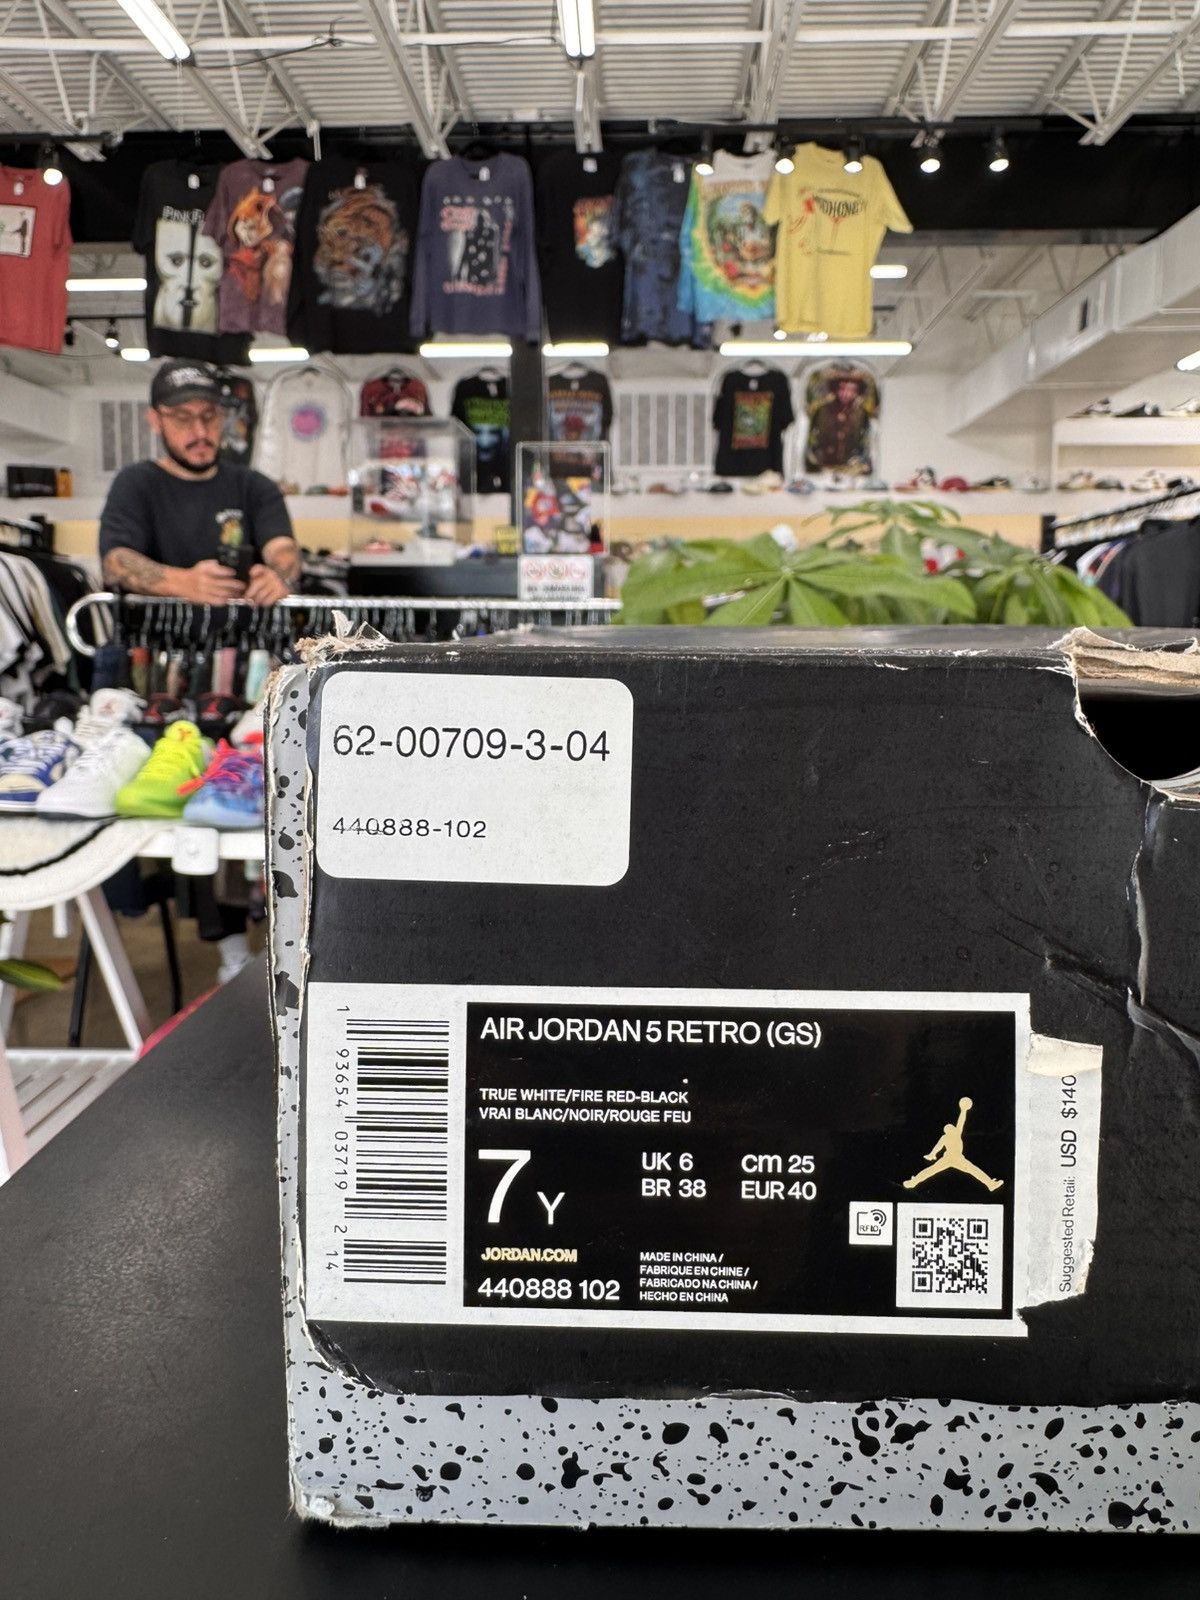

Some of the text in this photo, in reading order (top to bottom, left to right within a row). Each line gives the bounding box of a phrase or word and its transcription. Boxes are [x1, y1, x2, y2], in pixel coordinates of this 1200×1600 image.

[333, 724, 611, 763] 62-00709-3-04
[332, 817, 488, 839] 440888-102
[481, 1017, 822, 1049] AIR JORDAN 5 RETRO (GS)
[336, 1050, 349, 1108] 93654
[480, 1088, 689, 1103] TRUE WHITE/FIRE RED-BLACK
[1061, 1075, 1078, 1118] $140
[480, 1108, 691, 1123] VRAI BLANC/NOIR/ROUGE FEU
[1061, 1129, 1078, 1168] USD
[334, 1131, 348, 1190] 03719
[642, 1152, 693, 1172] UK 6
[741, 1153, 815, 1174] cm 25
[478, 1150, 565, 1226] 7 Y
[642, 1179, 707, 1199] BR 38
[741, 1181, 817, 1201] EUR 40
[326, 1251, 338, 1269] 14
[481, 1248, 578, 1263] JORDAN.COM
[640, 1252, 671, 1262] MADE
[672, 1252, 683, 1262] IN
[685, 1253, 716, 1263] CHINA
[1060, 1221, 1075, 1292] Suggested
[640, 1265, 692, 1276] FABRIQUE
[694, 1266, 708, 1275] EN
[710, 1266, 743, 1276] CHINE
[478, 1278, 620, 1301] 440888 102
[640, 1278, 701, 1289] FABRICADO
[703, 1279, 716, 1289] NA
[717, 1280, 751, 1290] CHINA
[640, 1292, 728, 1302] HECHO EN CHINA
